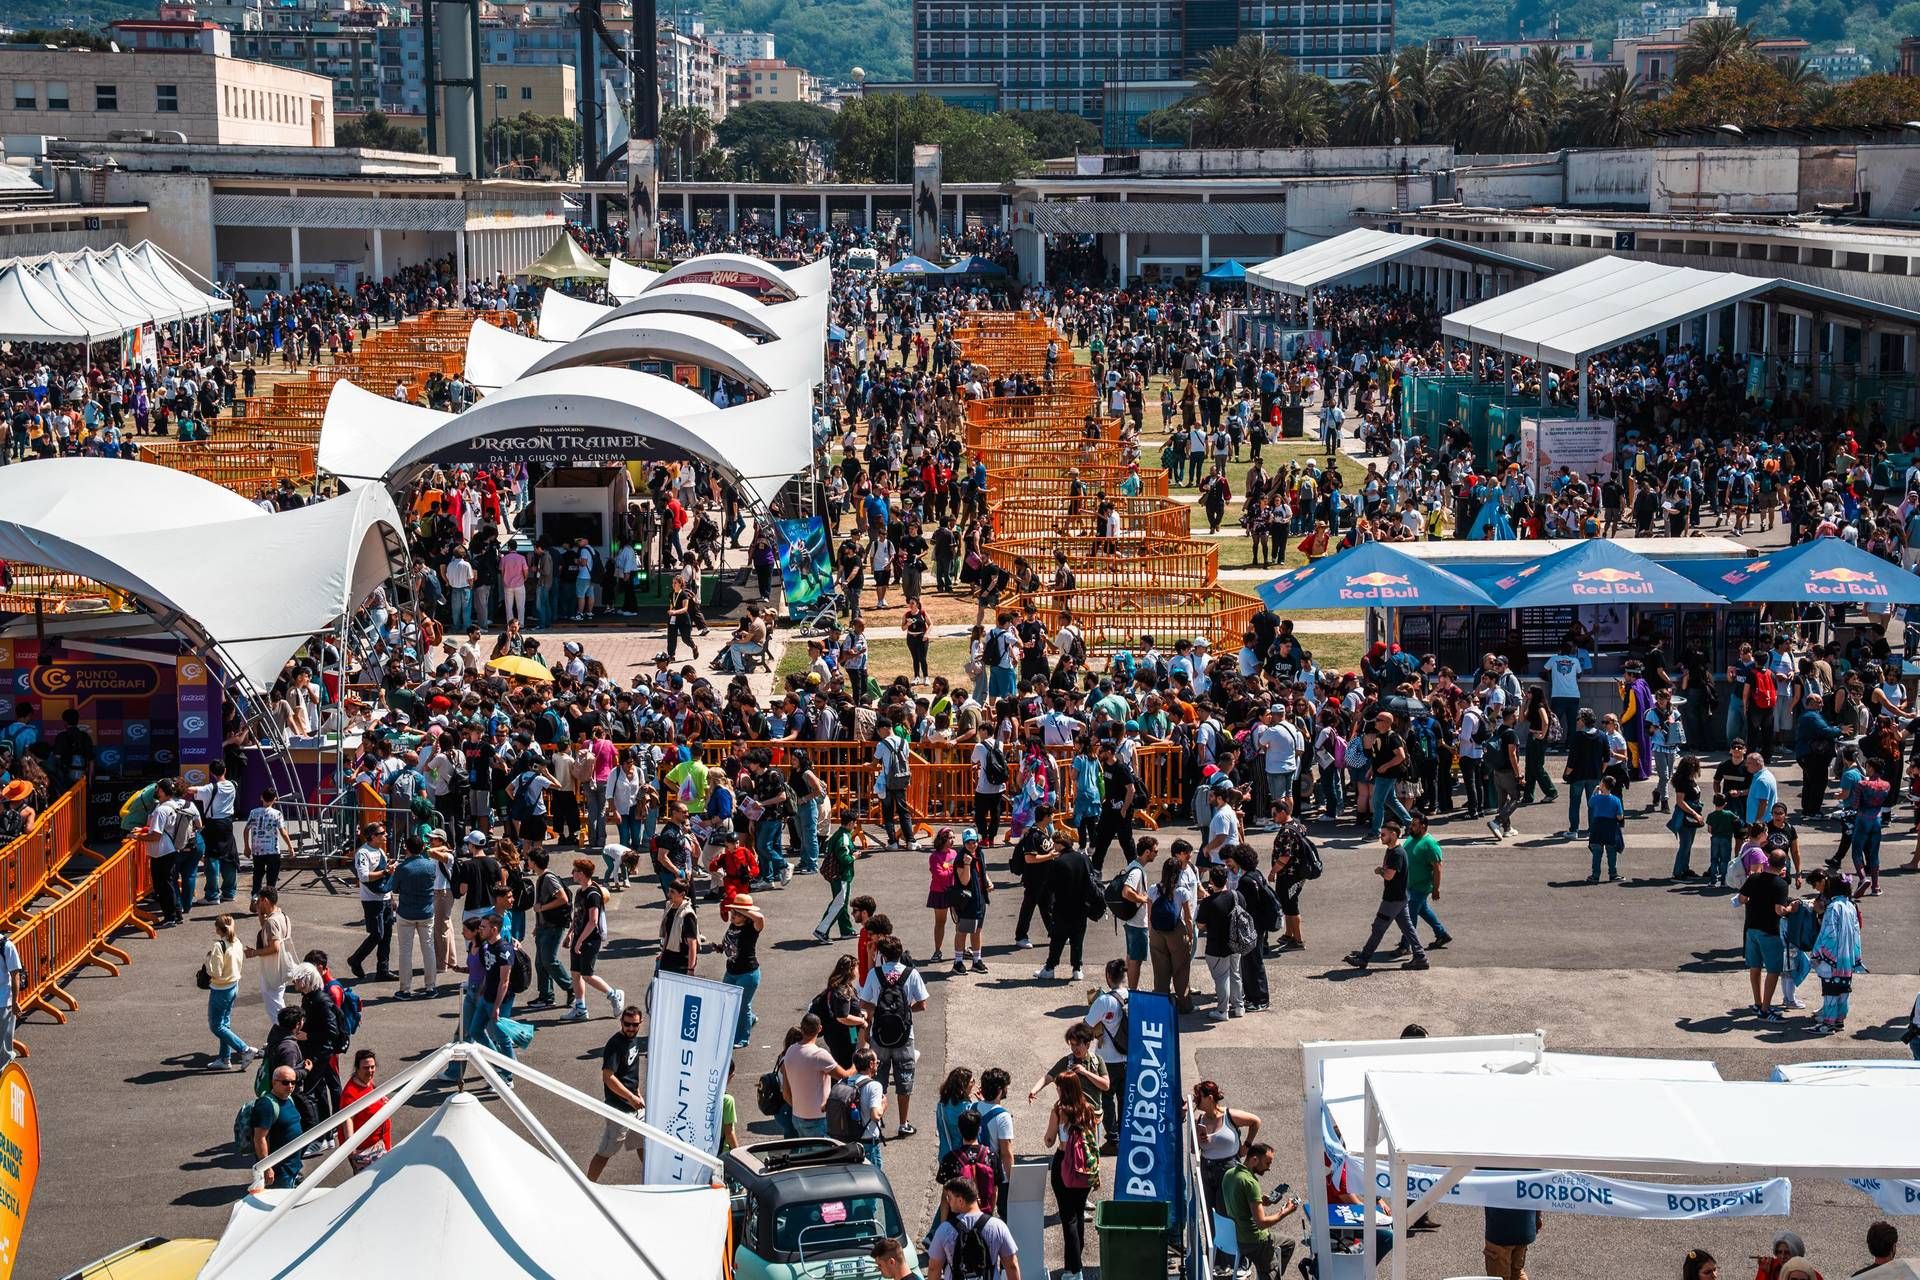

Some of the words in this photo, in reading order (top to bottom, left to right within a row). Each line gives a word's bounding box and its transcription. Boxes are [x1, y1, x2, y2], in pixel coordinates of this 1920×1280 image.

[88, 218, 98, 229] 10
[1621, 235, 1629, 248] 2
[711, 271, 739, 284] RING
[469, 435, 555, 451] DRAGON
[557, 434, 654, 450] TRAINER
[528, 454, 567, 462] GIUGNO
[588, 453, 626, 461] CINEMA
[1339, 587, 1378, 599] Red
[1381, 587, 1419, 598] Bull
[1572, 582, 1612, 595] Red
[1615, 582, 1654, 594] Bull
[1804, 582, 1847, 594] Red
[1849, 583, 1888, 596] Bull
[76, 670, 117, 679] PUNTO
[76, 679, 145, 689] AUTOGRAFI
[10, 1081, 25, 1128] FIAT
[704, 1068, 719, 1131] SERVICES
[1516, 1179, 1613, 1205] BORBONE
[1904, 1186, 1920, 1203] B
[1551, 1201, 1576, 1209] NAPOLI
[1667, 1186, 1763, 1212] BORBONE
